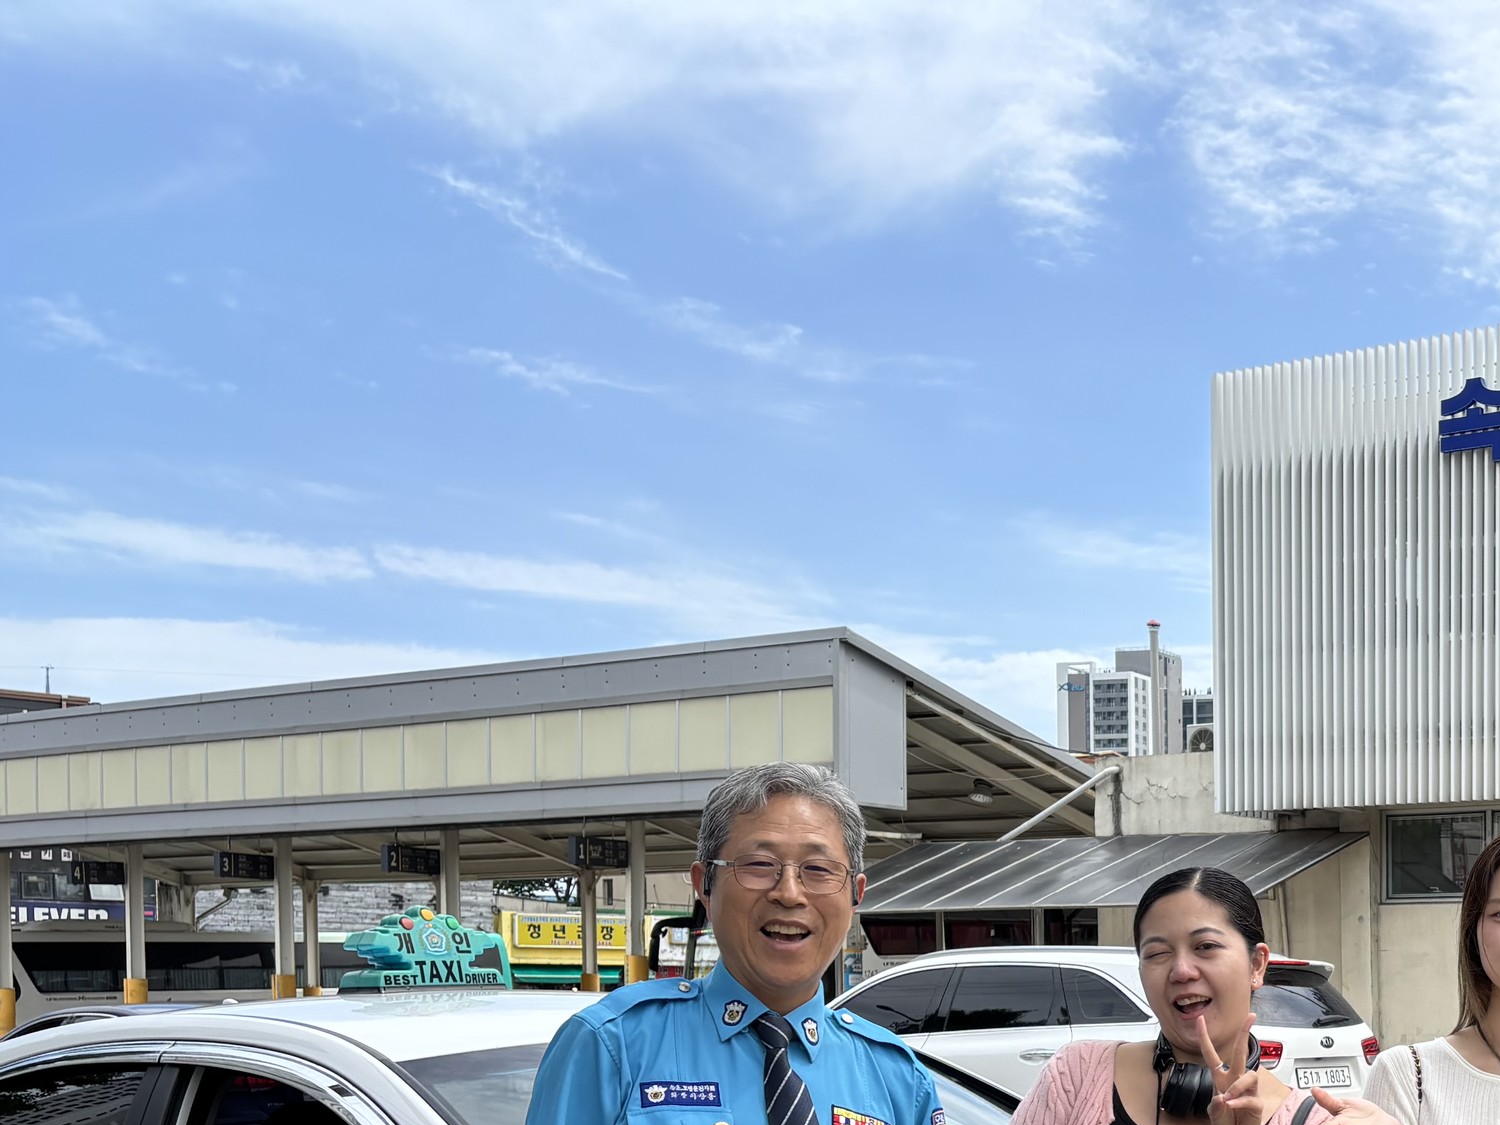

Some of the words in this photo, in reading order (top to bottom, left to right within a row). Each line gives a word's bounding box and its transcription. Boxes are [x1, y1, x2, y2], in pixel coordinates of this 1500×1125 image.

[390, 851, 397, 867] 2
[579, 844, 584, 859] 1
[222, 857, 229, 872] 3
[73, 866, 81, 880] 4
[393, 933, 415, 954] 개
[451, 932, 472, 954] 인
[384, 974, 419, 985] BEST
[415, 960, 465, 984] TAXI
[464, 973, 498, 984] DRIVER
[1325, 1069, 1346, 1084] 1803
